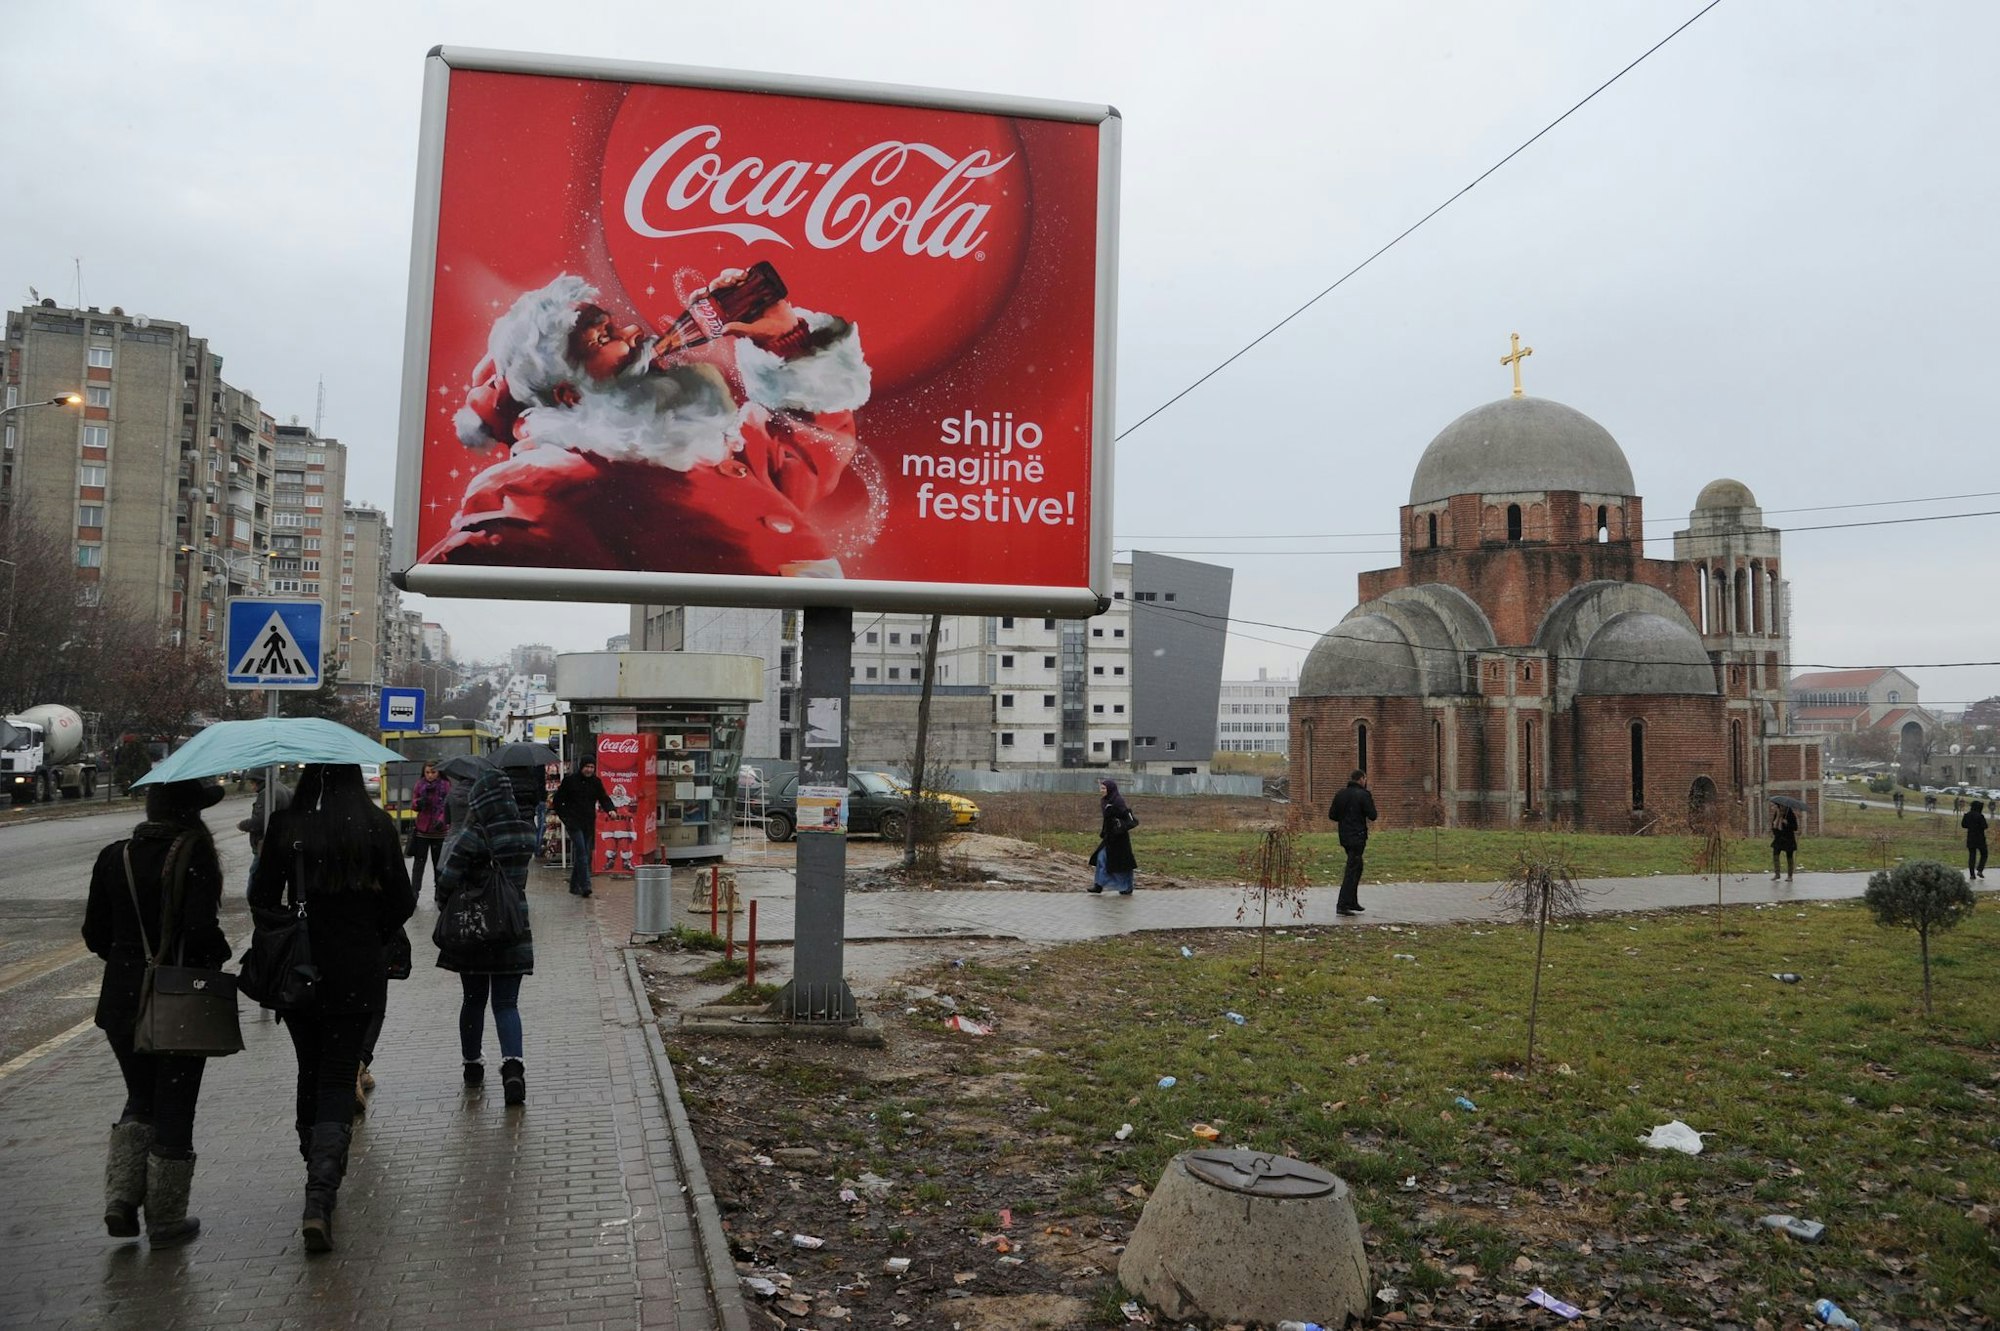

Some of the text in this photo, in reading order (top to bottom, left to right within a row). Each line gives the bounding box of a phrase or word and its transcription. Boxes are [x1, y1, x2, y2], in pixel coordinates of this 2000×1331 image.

[624, 125, 1016, 260] Coca-Cola
[940, 410, 1043, 454] shijo
[902, 452, 1045, 485] magjinë
[916, 482, 1075, 525] festive!
